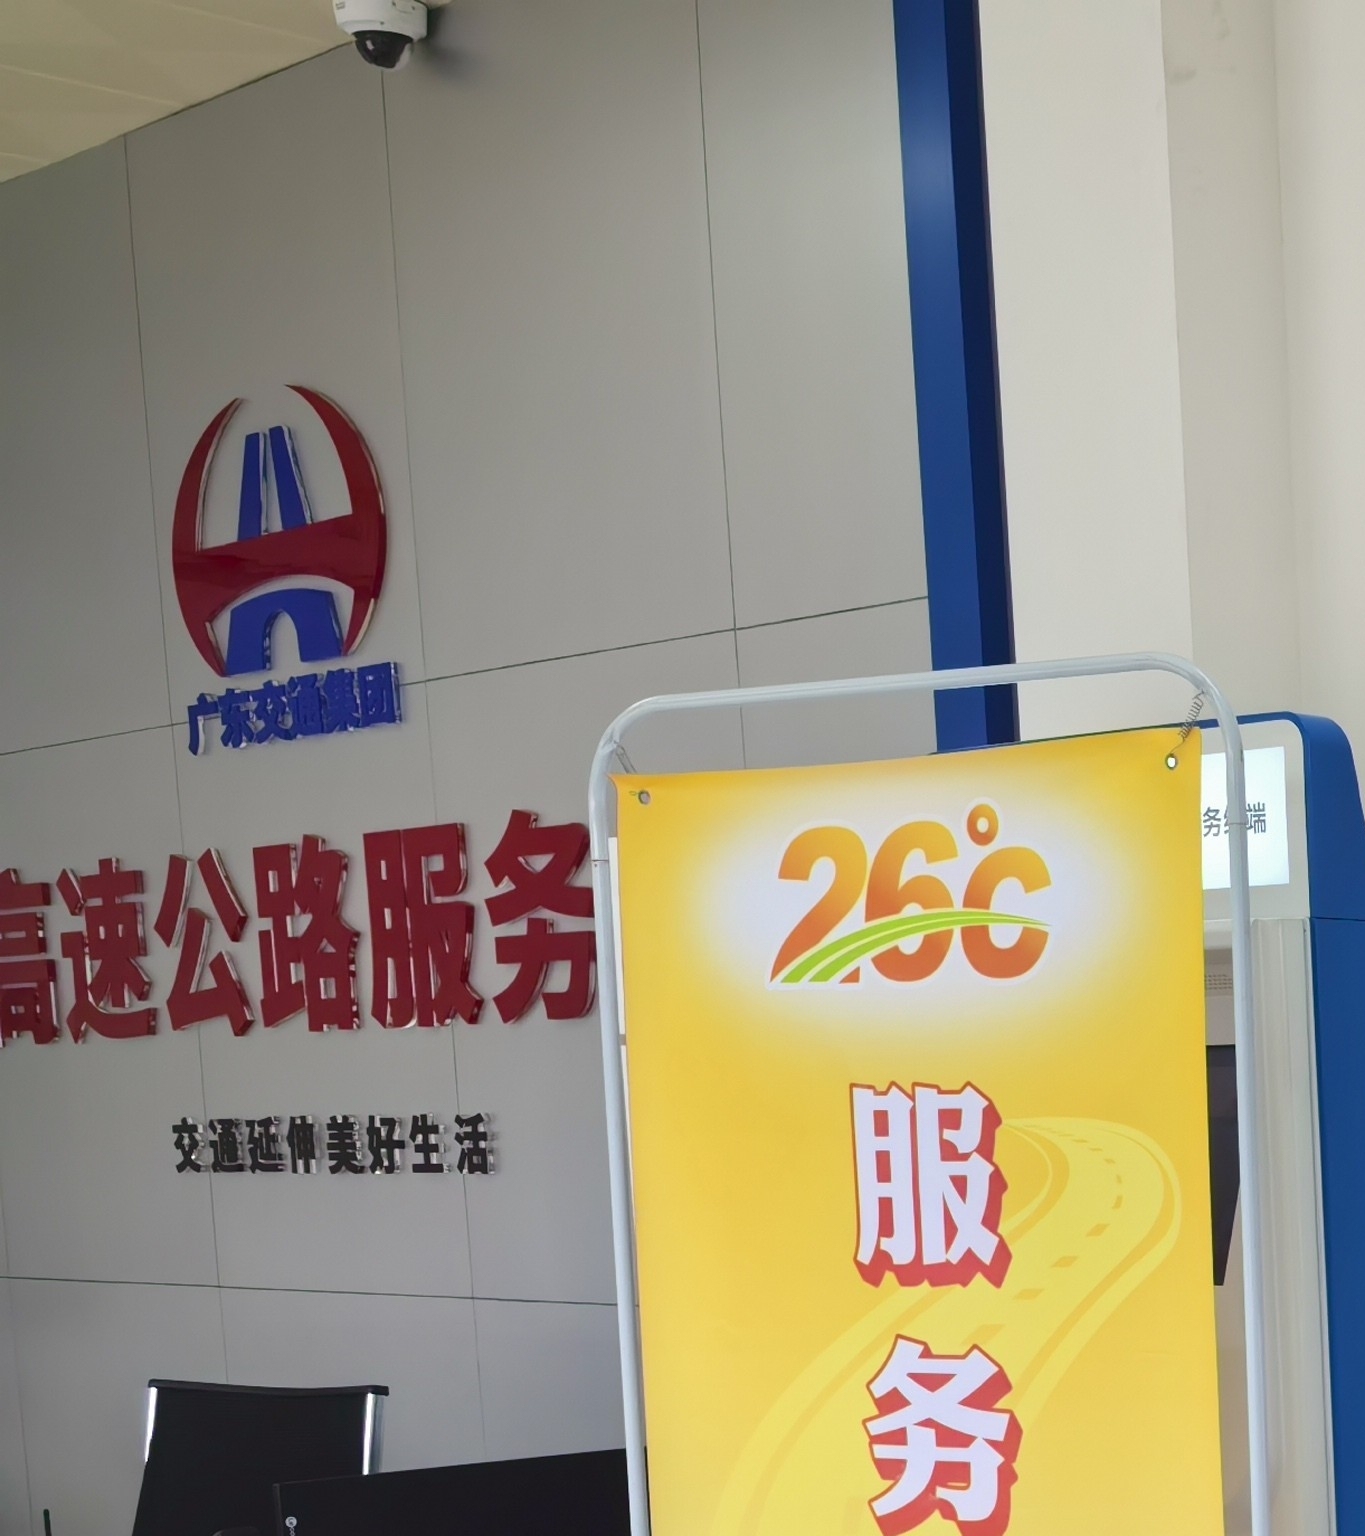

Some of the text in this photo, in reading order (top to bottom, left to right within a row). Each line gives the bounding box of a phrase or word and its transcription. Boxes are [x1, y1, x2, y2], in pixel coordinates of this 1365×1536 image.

[0, 809, 597, 1048] 高速公路服务
[172, 1112, 494, 1175] 交通延伸美好生活
